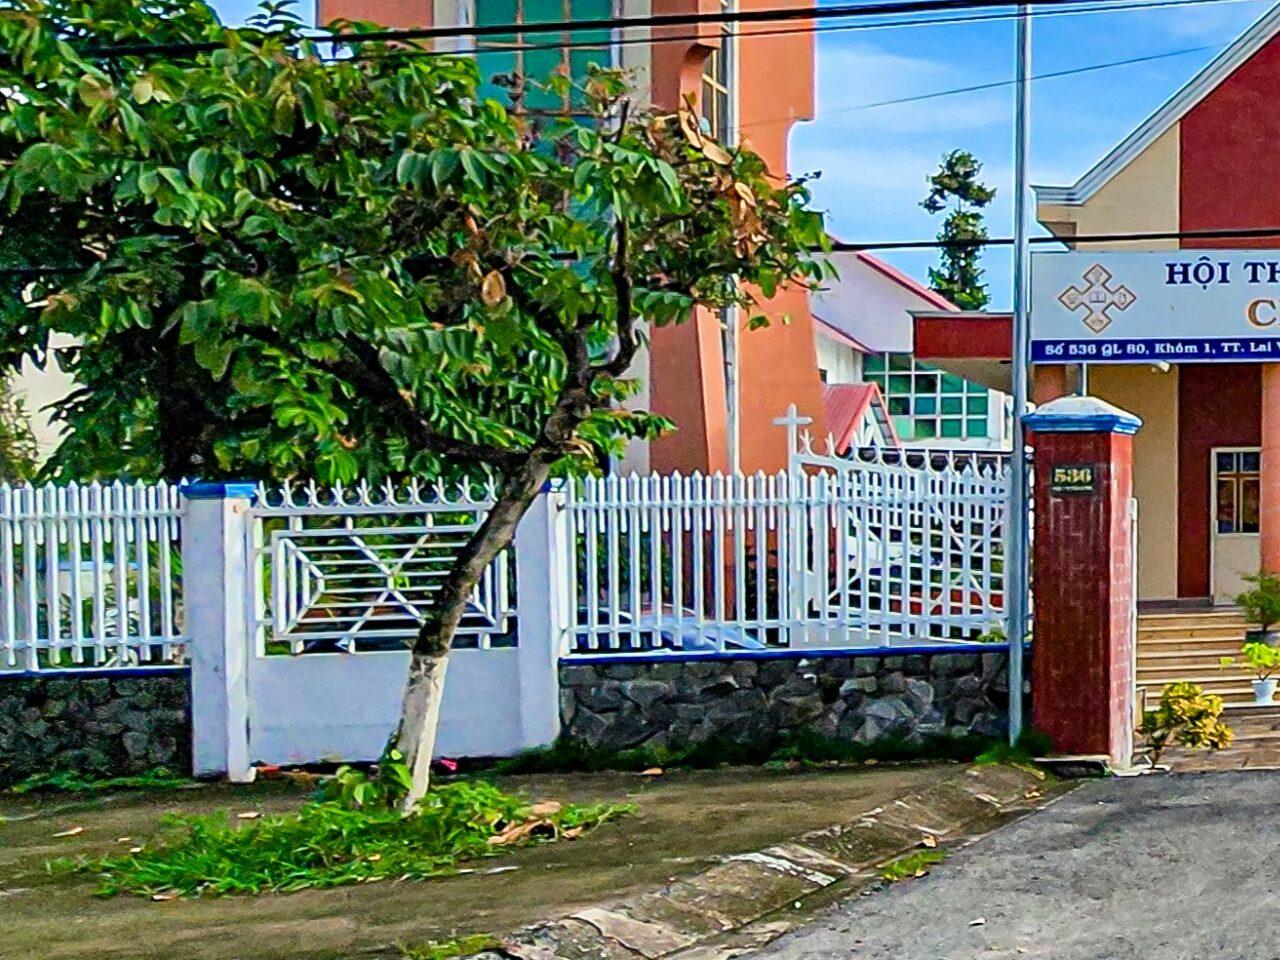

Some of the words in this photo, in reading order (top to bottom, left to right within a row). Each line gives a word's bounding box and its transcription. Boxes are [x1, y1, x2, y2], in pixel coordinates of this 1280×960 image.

[1165, 256, 1231, 290] HỘI
[1045, 343, 1065, 355] Số
[1068, 344, 1096, 355] 536
[1126, 343, 1150, 355] 80,
[1154, 342, 1198, 354] Khóm
[1221, 342, 1245, 353] TT.
[1250, 341, 1272, 352] Lai
[1054, 468, 1092, 483] 536
